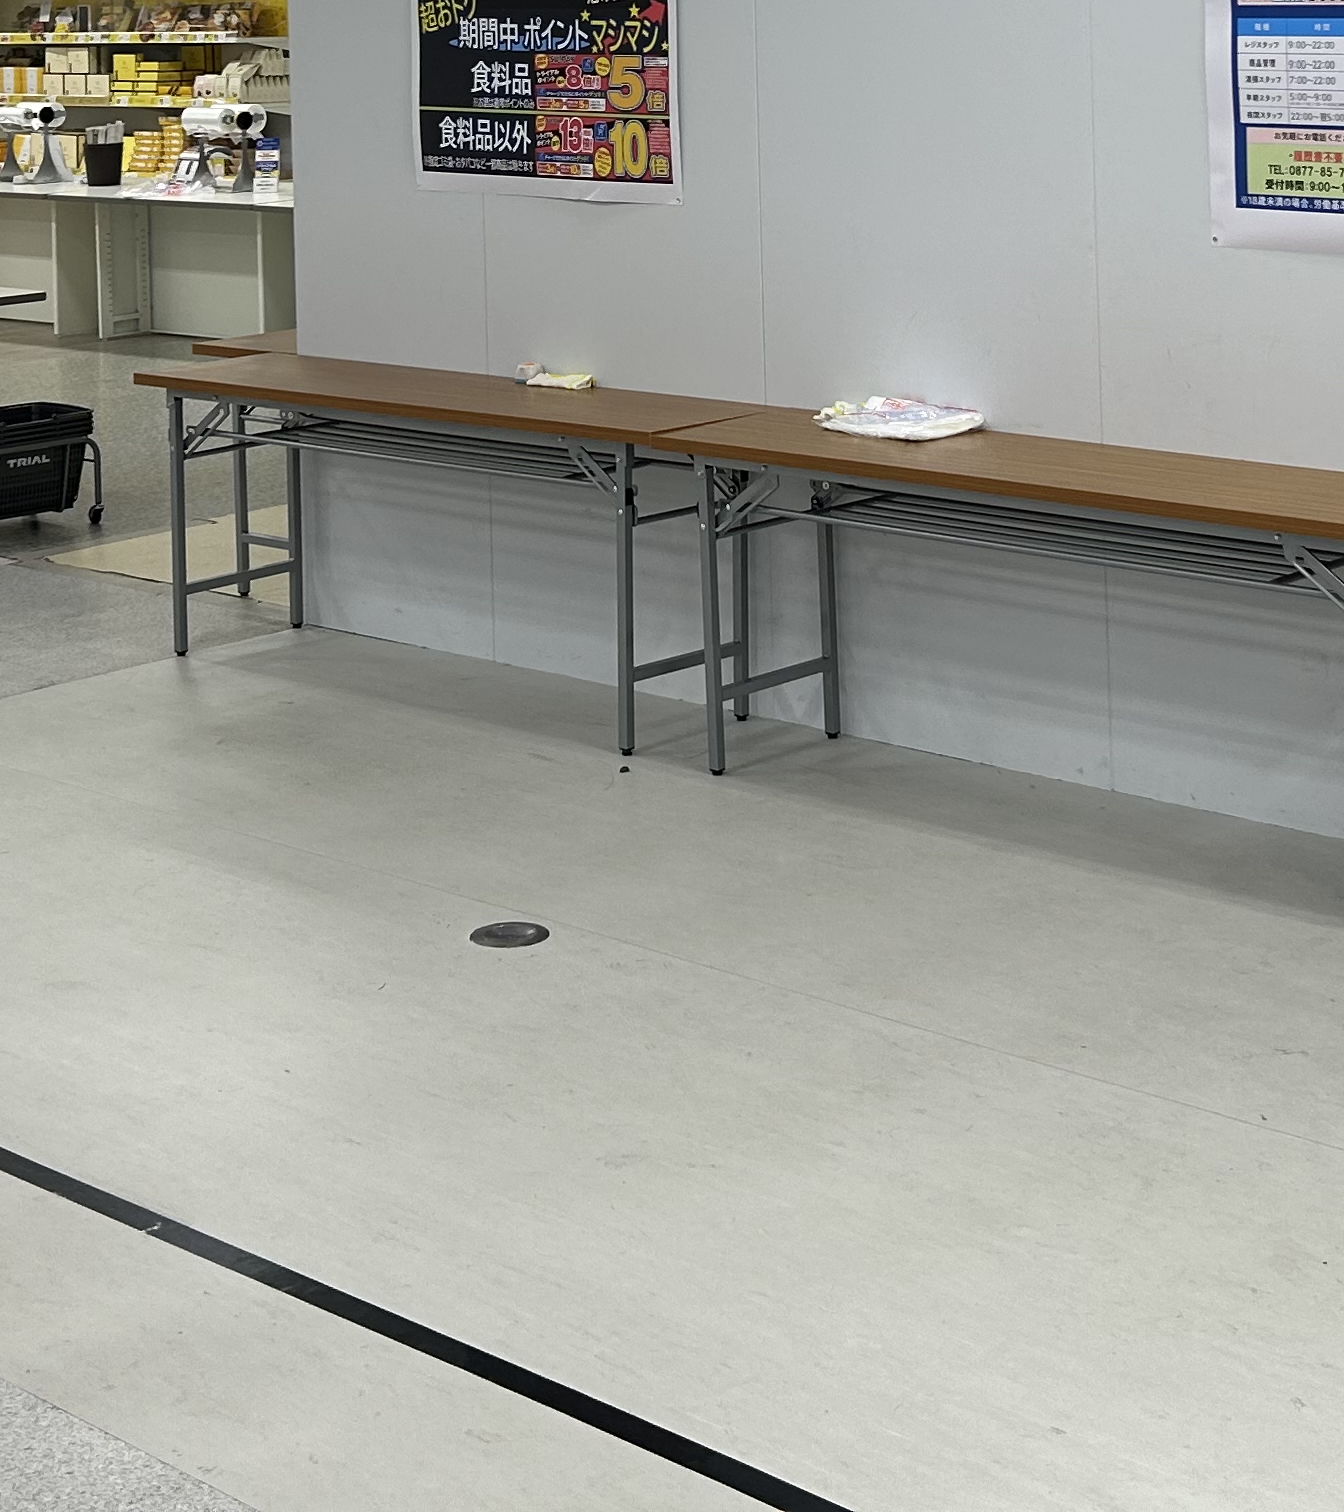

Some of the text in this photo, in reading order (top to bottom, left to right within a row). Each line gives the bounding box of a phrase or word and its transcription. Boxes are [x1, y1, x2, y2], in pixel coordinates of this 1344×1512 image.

[471, 61, 532, 95] 食料品
[439, 116, 532, 154] 食料品以外
[6, 454, 51, 469] TRIAL
